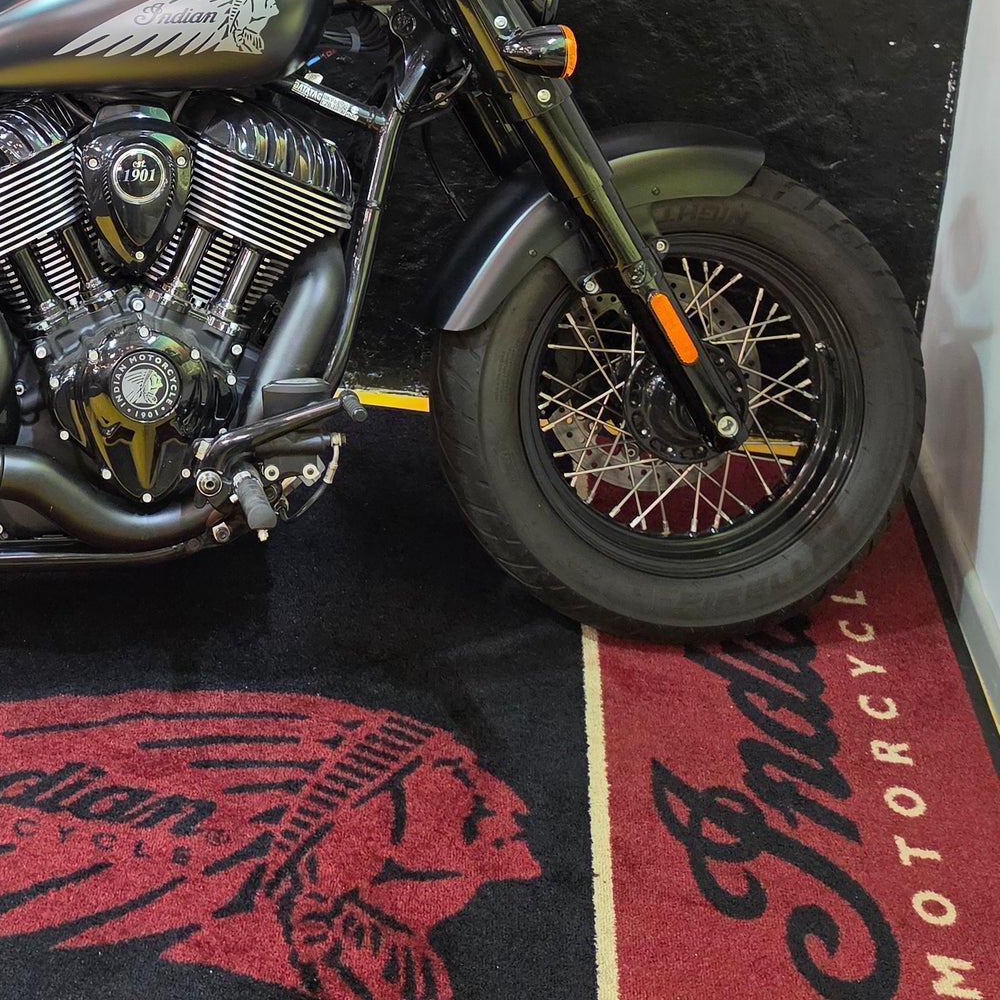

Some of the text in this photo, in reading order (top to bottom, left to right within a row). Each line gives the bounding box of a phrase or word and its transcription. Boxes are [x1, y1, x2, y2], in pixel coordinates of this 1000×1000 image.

[133, 2, 218, 26] Indian
[123, 168, 156, 182] 1901
[113, 354, 178, 408] INDIAN MOTORCYCLE
[135, 410, 159, 418] 1901
[830, 590, 984, 1000] MOTORCYCL
